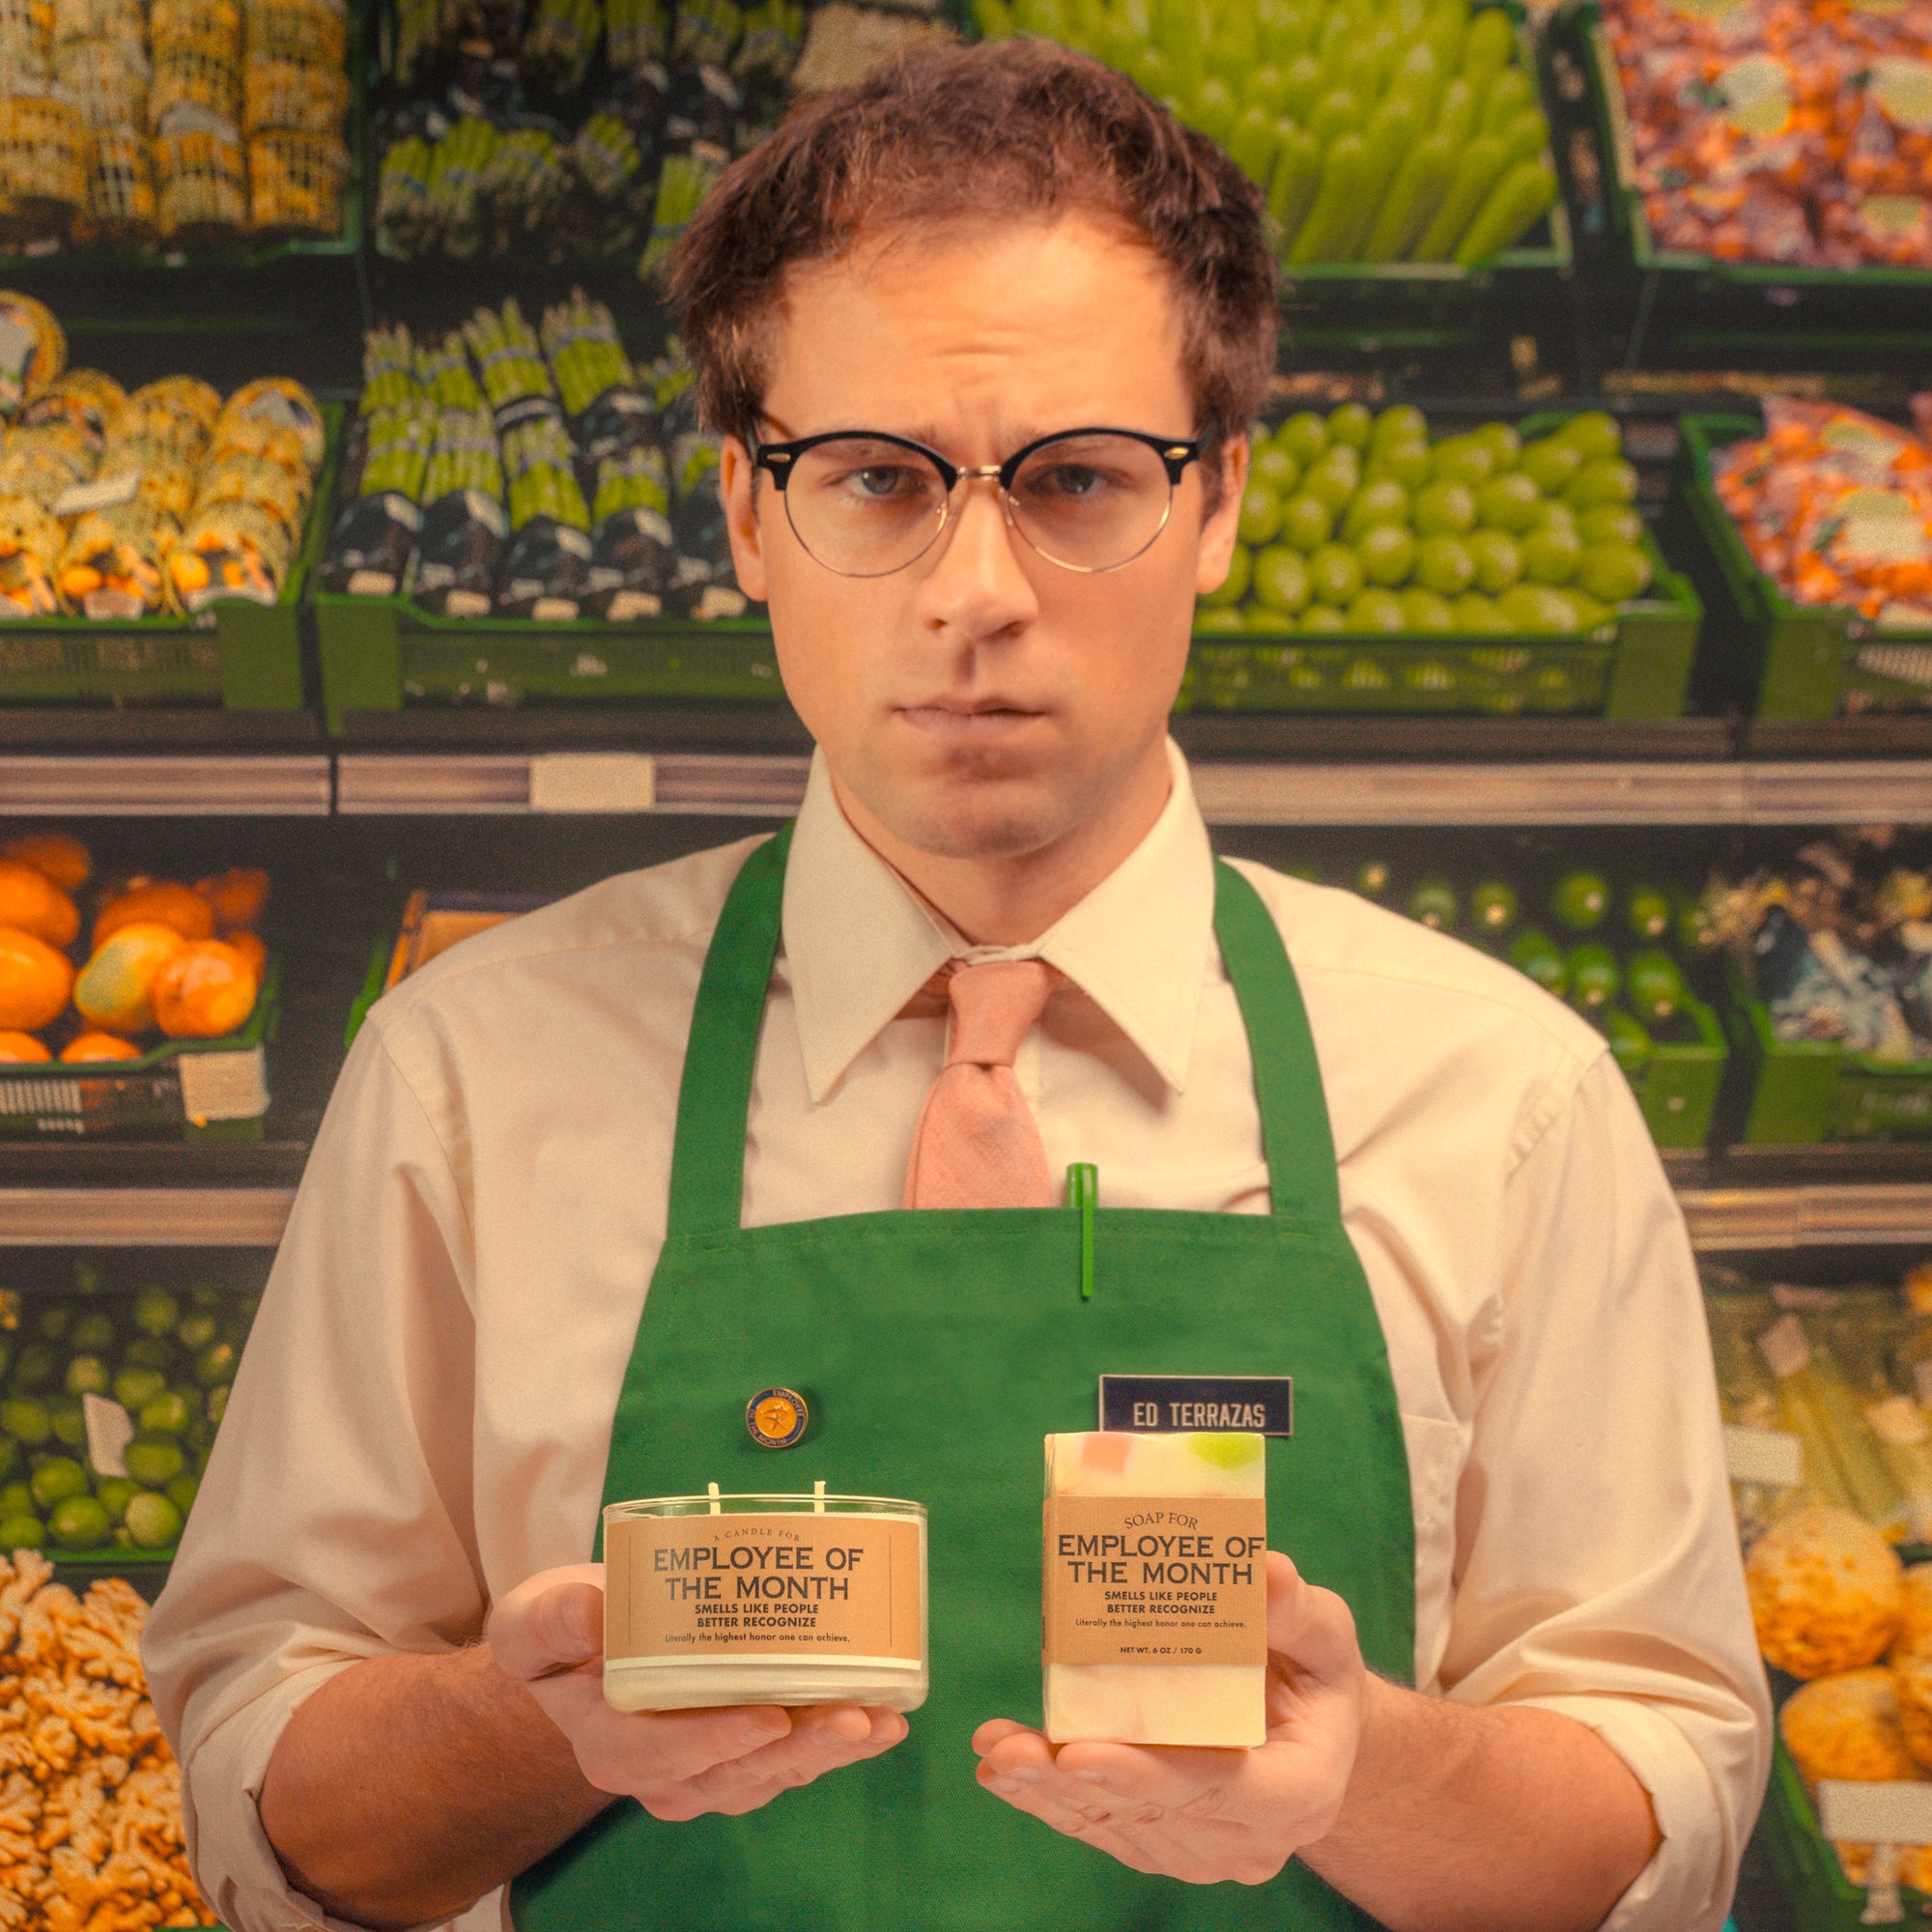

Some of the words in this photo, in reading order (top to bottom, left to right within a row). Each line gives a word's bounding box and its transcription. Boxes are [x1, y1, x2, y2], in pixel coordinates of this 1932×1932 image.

[1133, 1402, 1159, 1427] ED
[1169, 1402, 1266, 1428] TERRAZAS
[1123, 1512, 1165, 1529] SOAP
[1168, 1512, 1198, 1530] FOR
[724, 1527, 773, 1540] CANDLE
[779, 1530, 801, 1542] FOR
[1058, 1534, 1214, 1557] EMPLOYEE
[1225, 1536, 1265, 1558] OF
[653, 1546, 813, 1572] EMPLOYEE
[825, 1548, 864, 1571] OF
[1067, 1560, 1128, 1583] THE
[1143, 1562, 1253, 1585] MONTH
[665, 1576, 722, 1601] THE
[736, 1576, 849, 1601] MONTH
[1104, 1591, 1146, 1601] SMELLS
[1149, 1591, 1173, 1601] LIKE
[1177, 1592, 1218, 1602] PEOPLE
[695, 1604, 739, 1614] SMELLS
[743, 1604, 769, 1614] LIKE
[774, 1604, 819, 1614] PEOPLE
[1107, 1604, 1146, 1614] BETTER
[1150, 1605, 1215, 1614] RECOGNIZE
[697, 1616, 739, 1628] BETTER
[743, 1616, 817, 1628] RECOGNIZE
[1075, 1618, 1107, 1629] Literally
[1109, 1618, 1122, 1627] the
[1124, 1618, 1153, 1629] highest
[1155, 1619, 1179, 1628] honor
[1214, 1619, 1246, 1629] achieve.
[665, 1633, 696, 1644] Literally
[699, 1633, 712, 1642] the
[715, 1632, 747, 1643] highest
[750, 1633, 776, 1641] honor
[816, 1633, 851, 1642] achieve.
[1179, 1646, 1194, 1655] 170
